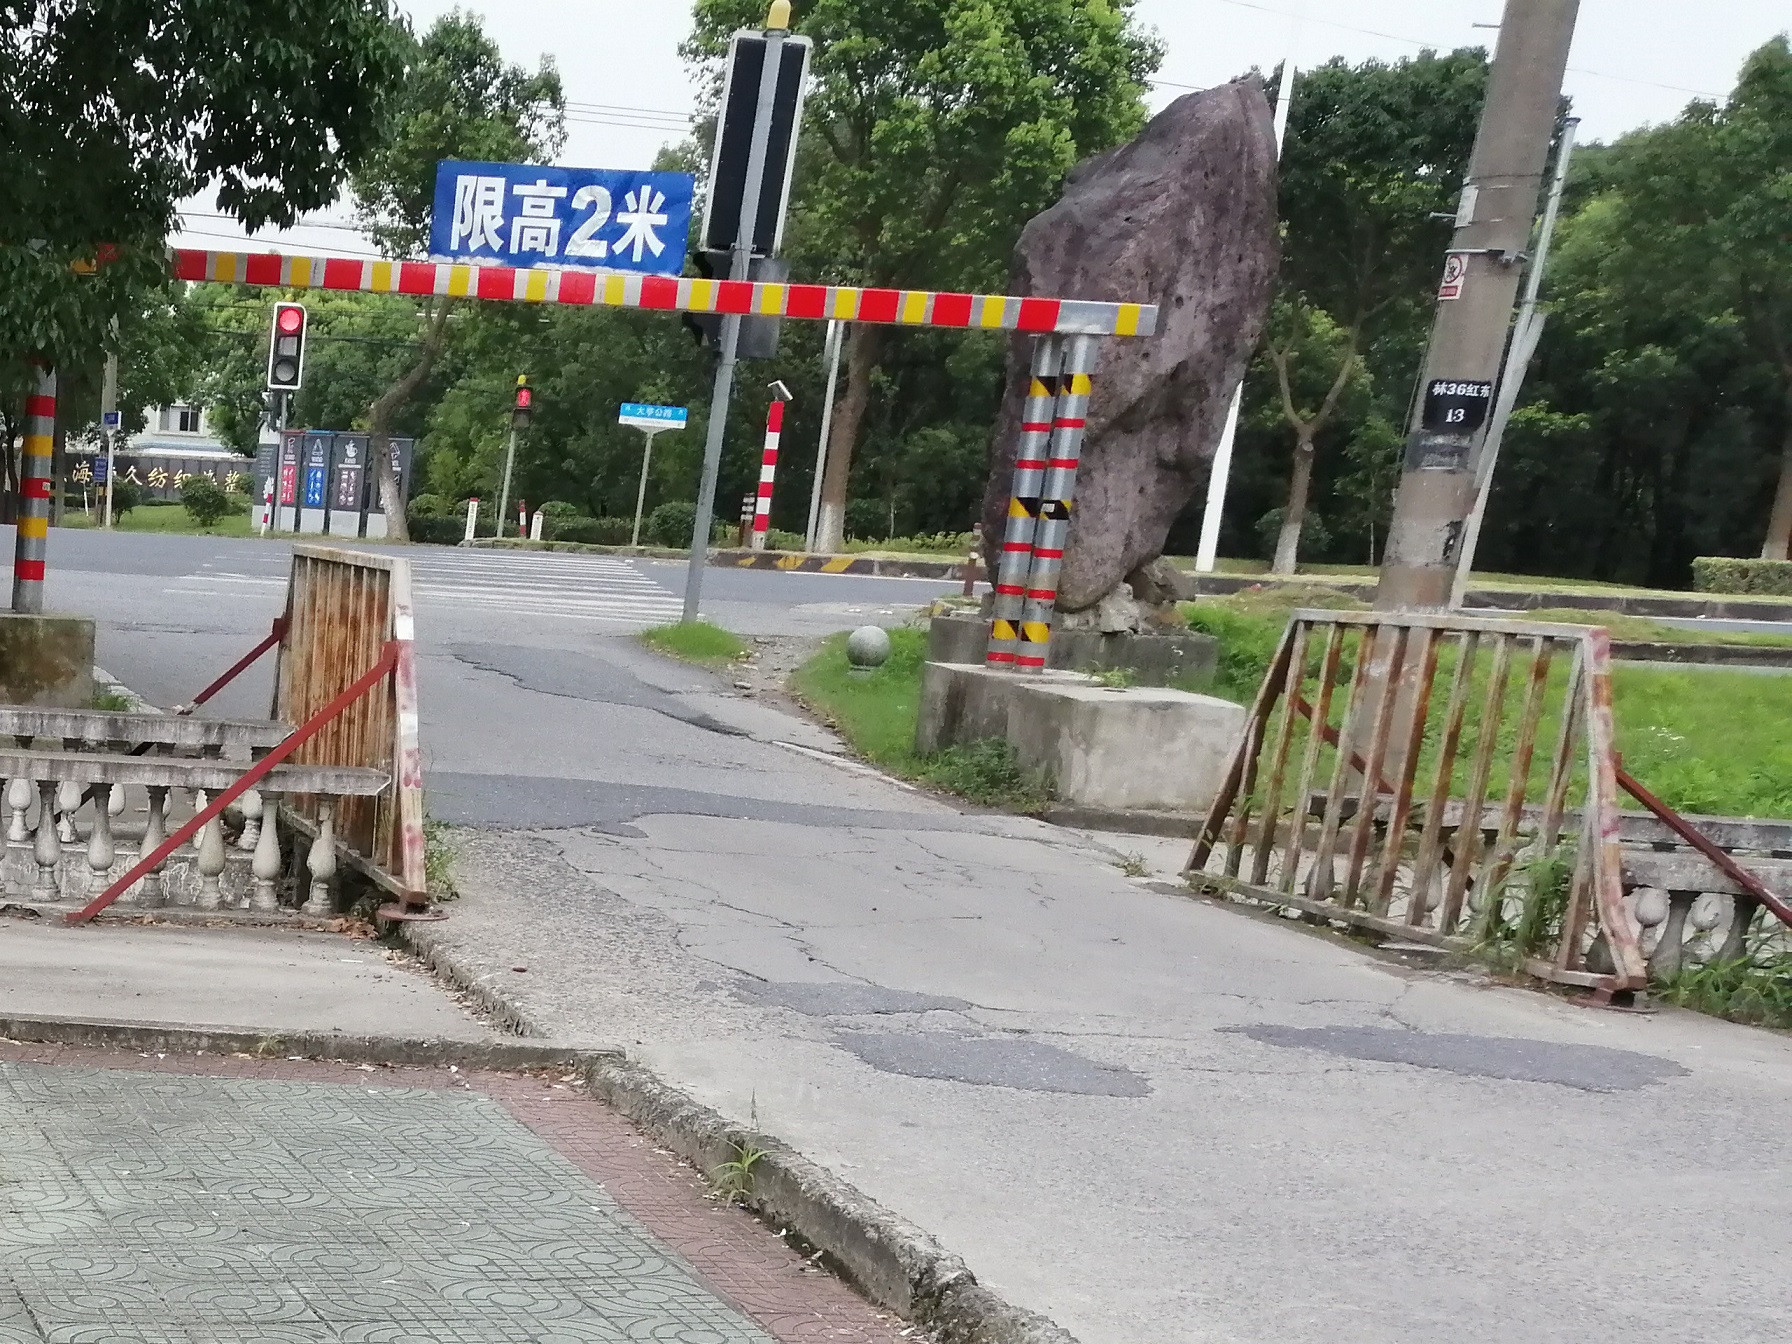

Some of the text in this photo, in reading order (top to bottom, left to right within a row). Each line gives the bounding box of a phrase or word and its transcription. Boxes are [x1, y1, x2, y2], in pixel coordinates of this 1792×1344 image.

[450, 174, 668, 262] 限高2米
[1445, 408, 1465, 422] 13
